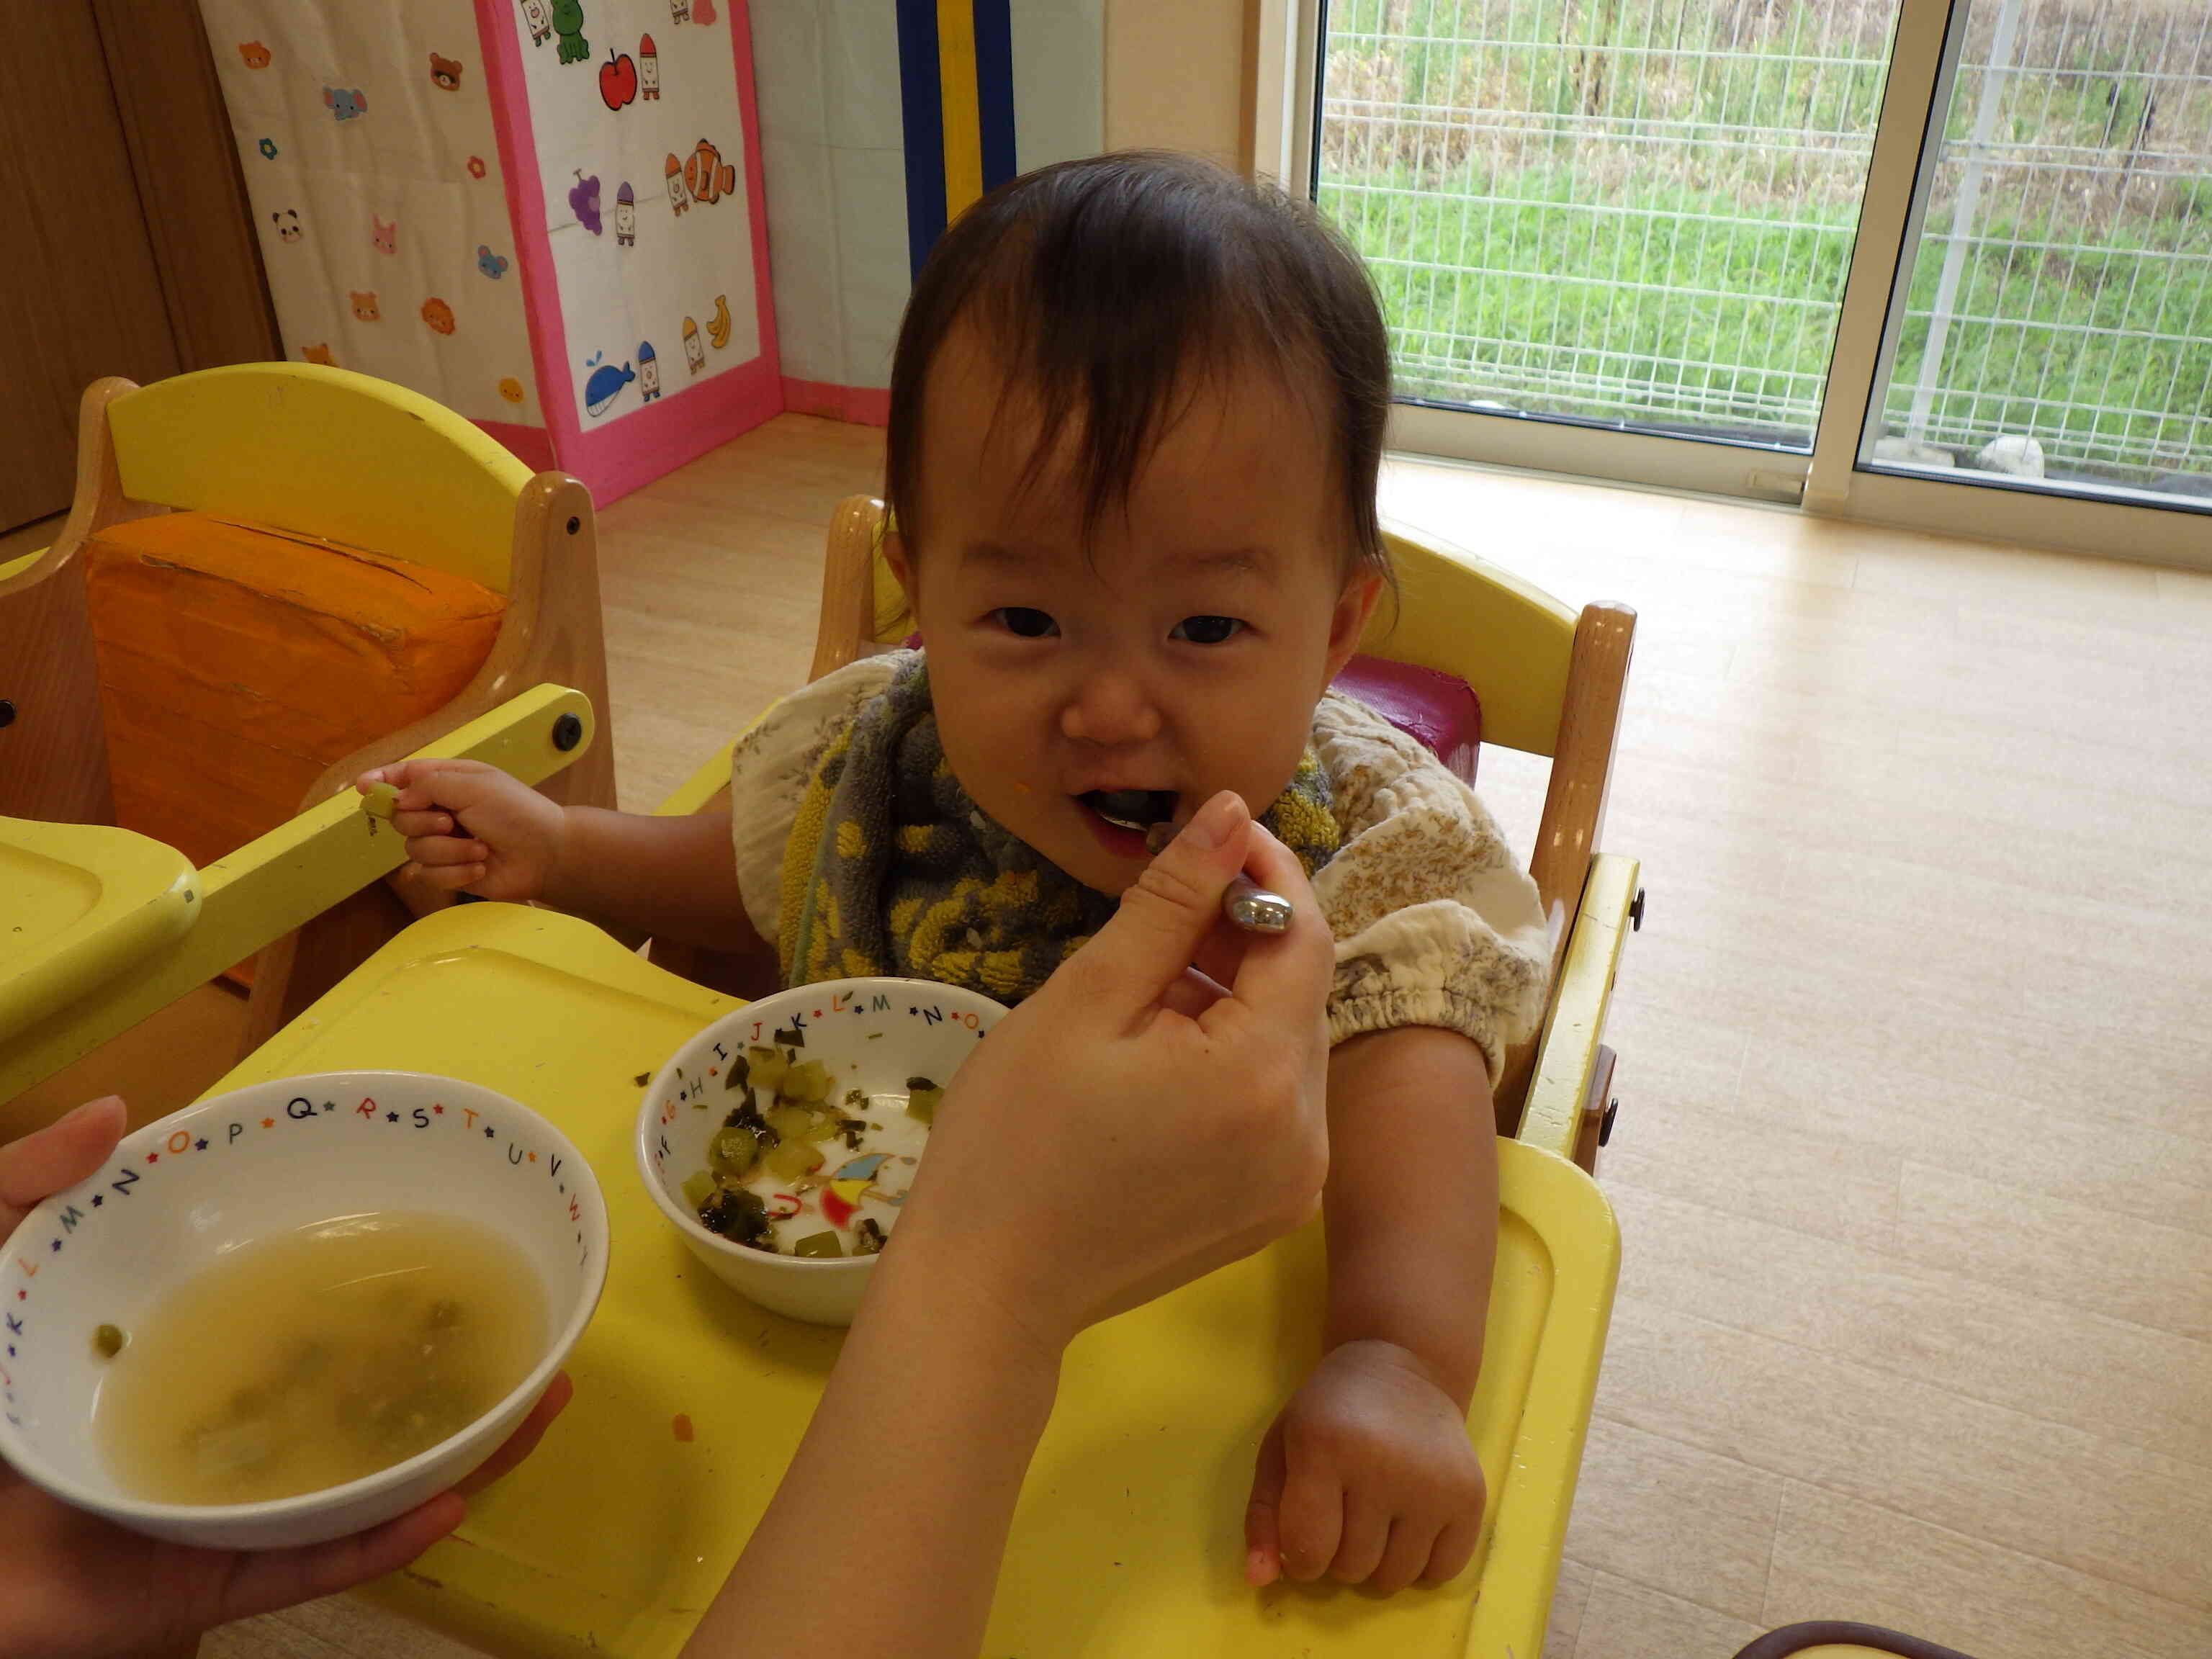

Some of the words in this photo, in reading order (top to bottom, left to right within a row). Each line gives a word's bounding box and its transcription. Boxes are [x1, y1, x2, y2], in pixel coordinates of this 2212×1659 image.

[750, 1022, 763, 1041] J
[791, 1013, 807, 1030] K
[833, 995, 843, 1012] L
[872, 995, 891, 1012] M
[923, 1006, 943, 1025] N
[964, 1013, 979, 1030] O
[60, 1205, 84, 1234] M
[112, 1169, 140, 1195] N
[168, 1130, 190, 1154] O
[228, 1123, 244, 1144] P
[287, 1097, 318, 1119] Q
[356, 1097, 377, 1118] R
[413, 1108, 430, 1128] S
[463, 1108, 479, 1129] T
[508, 1143, 522, 1164] U
[550, 1154, 562, 1177] V
